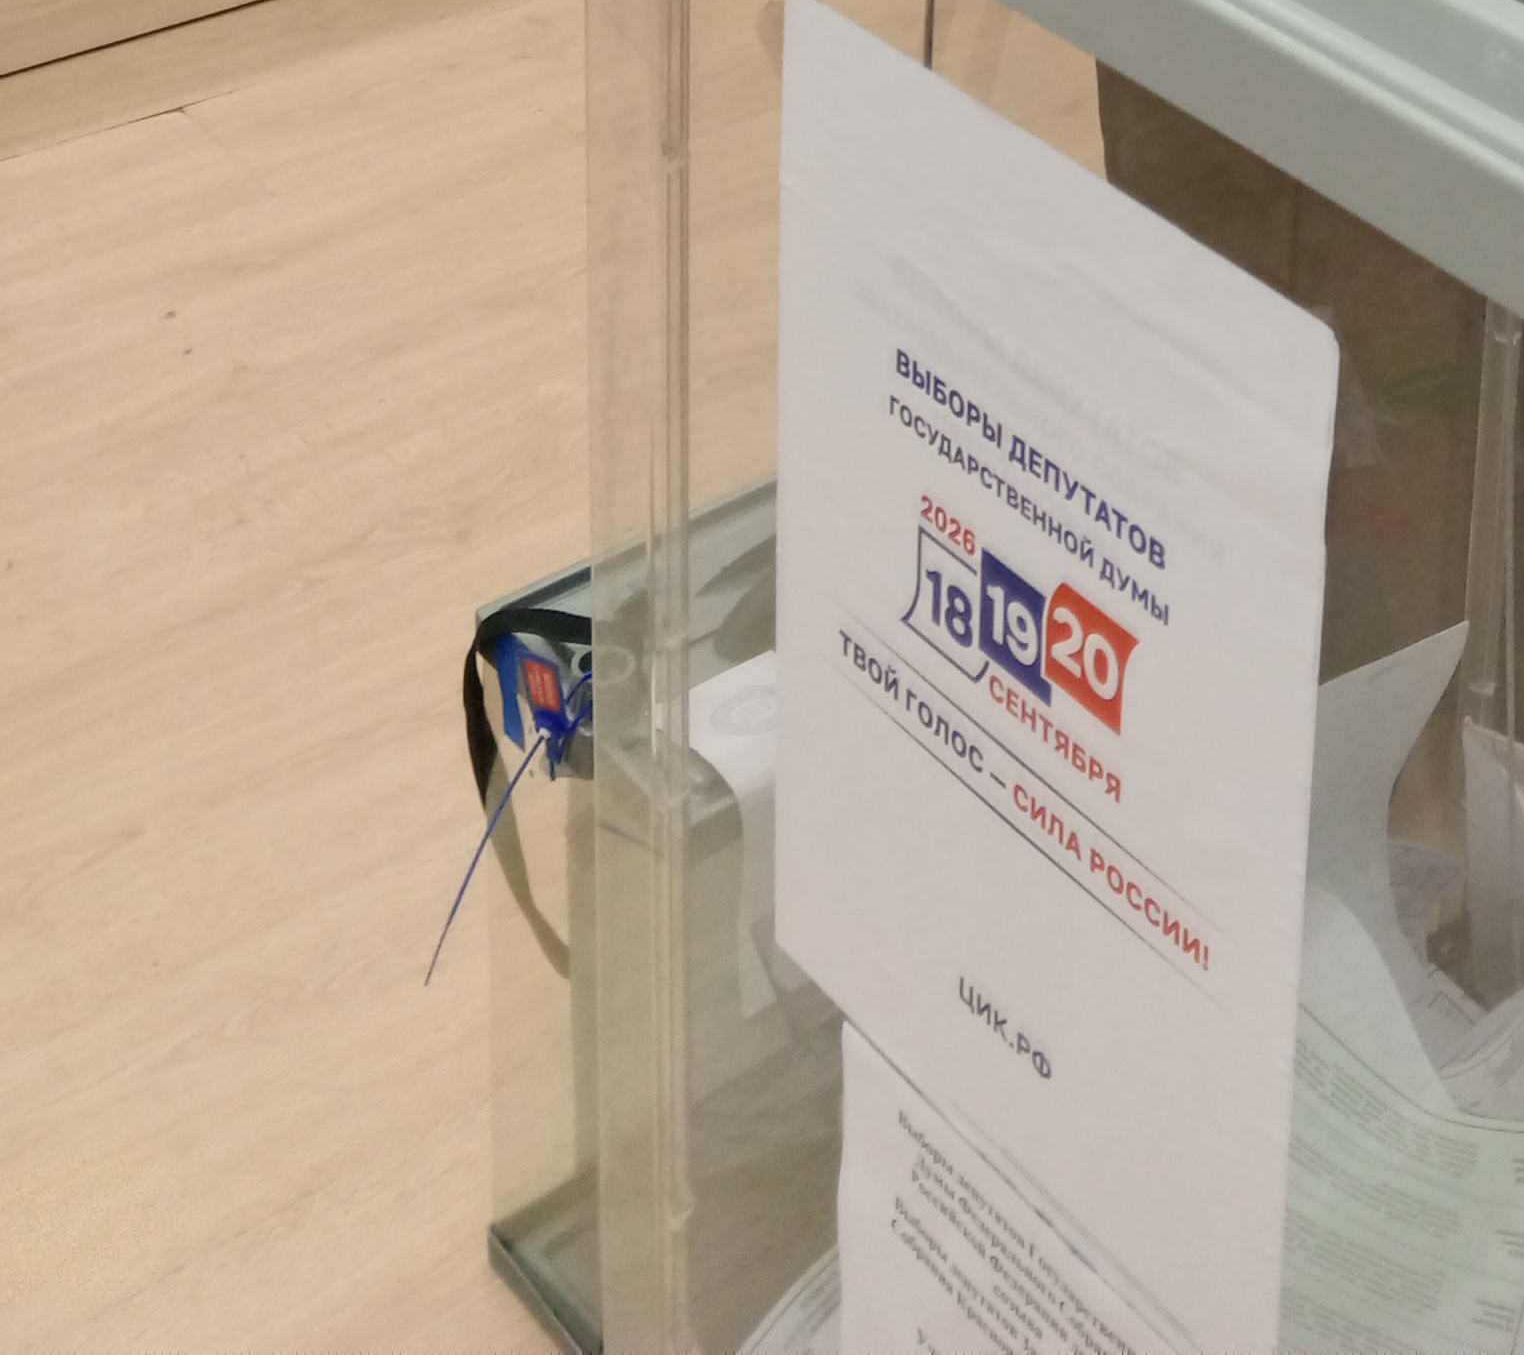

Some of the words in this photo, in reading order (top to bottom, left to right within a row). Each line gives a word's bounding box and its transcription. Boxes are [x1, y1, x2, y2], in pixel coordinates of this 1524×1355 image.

[888, 394, 1095, 569] ГОСУДАРСТВЕННОЙ
[1100, 556, 1170, 626] ДУМЫ
[895, 348, 1003, 450] ВЫБОРЫ
[1009, 435, 1167, 571] ДЕПУТАТОВ
[920, 494, 977, 558] 2026
[925, 566, 975, 649] 18
[986, 585, 1041, 668] 19
[1051, 614, 1122, 702] 20
[838, 628, 900, 697] ТВОЙ
[904, 686, 985, 775] ГОЛОС
[1012, 781, 1083, 862] СИЛА
[1089, 845, 1211, 972] РОССИИ!
[987, 674, 1122, 804] СЕНТЯБРЯ
[957, 975, 1053, 1081] ЦИК.РФ
